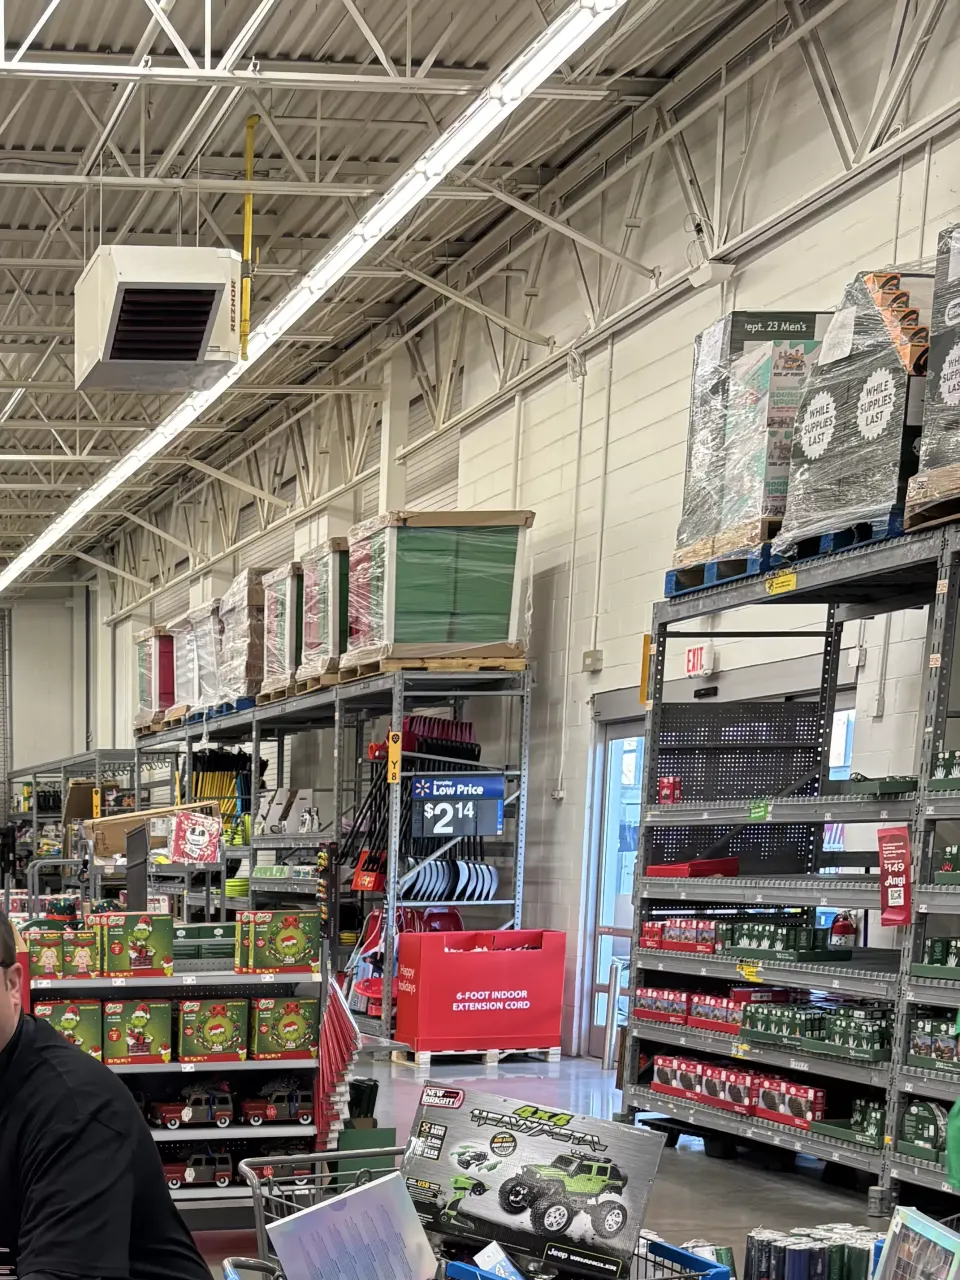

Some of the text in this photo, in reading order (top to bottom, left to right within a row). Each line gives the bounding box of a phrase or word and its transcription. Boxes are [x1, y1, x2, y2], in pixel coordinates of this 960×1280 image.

[744, 321, 807, 334] ept. 23 Men's
[866, 381, 889, 397] WHILE
[860, 393, 893, 414] SUPPLIES
[809, 403, 830, 419] WHILE
[865, 411, 884, 426] LAST
[804, 417, 833, 435] SUPPLIES
[808, 433, 825, 447] LAST
[686, 647, 704, 673] EXIT
[391, 760, 399, 769] Y
[391, 772, 397, 781] 8
[433, 784, 484, 795] Low Price
[884, 863, 905, 873] $149
[884, 875, 906, 887] Angi
[400, 964, 415, 979] Happy
[398, 980, 416, 995] holidays
[456, 990, 528, 1000] 6-FOOT INDOOR
[452, 1000, 530, 1011] EXTENSION CORD
[426, 1089, 445, 1097] NEW
[424, 1096, 455, 1106] BRIGHT
[470, 1108, 543, 1134] HEAVY
[417, 1180, 430, 1189] USB
[547, 1247, 618, 1273] Jeep WRANGLER
